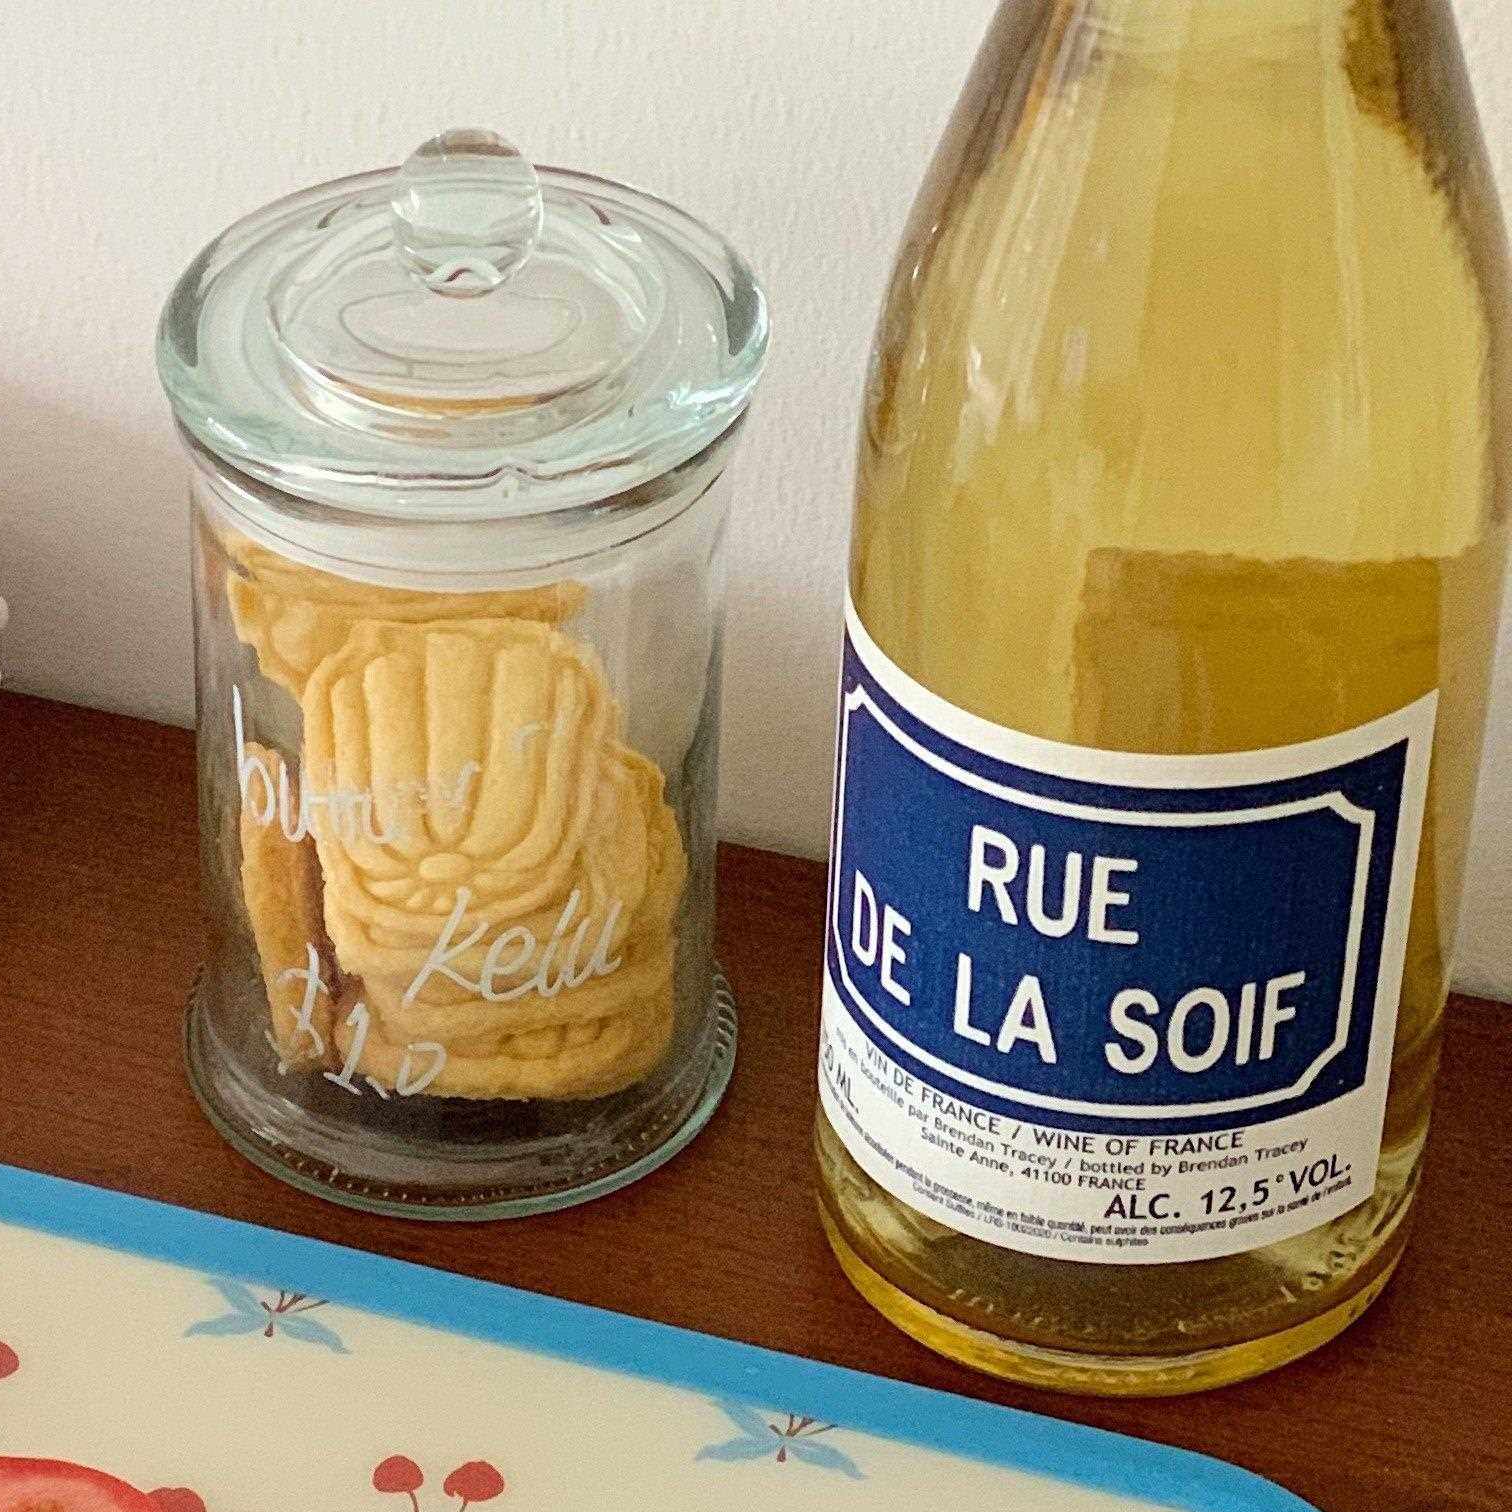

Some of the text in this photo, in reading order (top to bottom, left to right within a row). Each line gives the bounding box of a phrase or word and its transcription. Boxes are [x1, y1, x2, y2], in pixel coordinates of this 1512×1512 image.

[967, 824, 1139, 945] RUE
[851, 868, 912, 1006] DE
[953, 952, 1057, 1065] LA
[1104, 969, 1306, 1076] SOIF
[865, 1038, 889, 1075] VIN
[893, 1067, 915, 1096] DE
[921, 1086, 1001, 1136] FRANCE
[1011, 1124, 1022, 1140] /
[1033, 1128, 1096, 1155] WINE
[1105, 1137, 1138, 1157] OF
[1149, 1129, 1246, 1156] FRANCE
[908, 1104, 930, 1124] par
[934, 1116, 996, 1152] Brendan
[1000, 1142, 1058, 1169] Tracey
[1064, 1157, 1073, 1170] /
[1080, 1158, 1145, 1176] bottled
[1151, 1162, 1173, 1178] by
[1178, 1153, 1249, 1174] Brendan
[1254, 1137, 1309, 1162] Tracey
[920, 1126, 1146, 1191] Sainte Anne, 41100 FRANCE
[1104, 1192, 1181, 1220] ALC.
